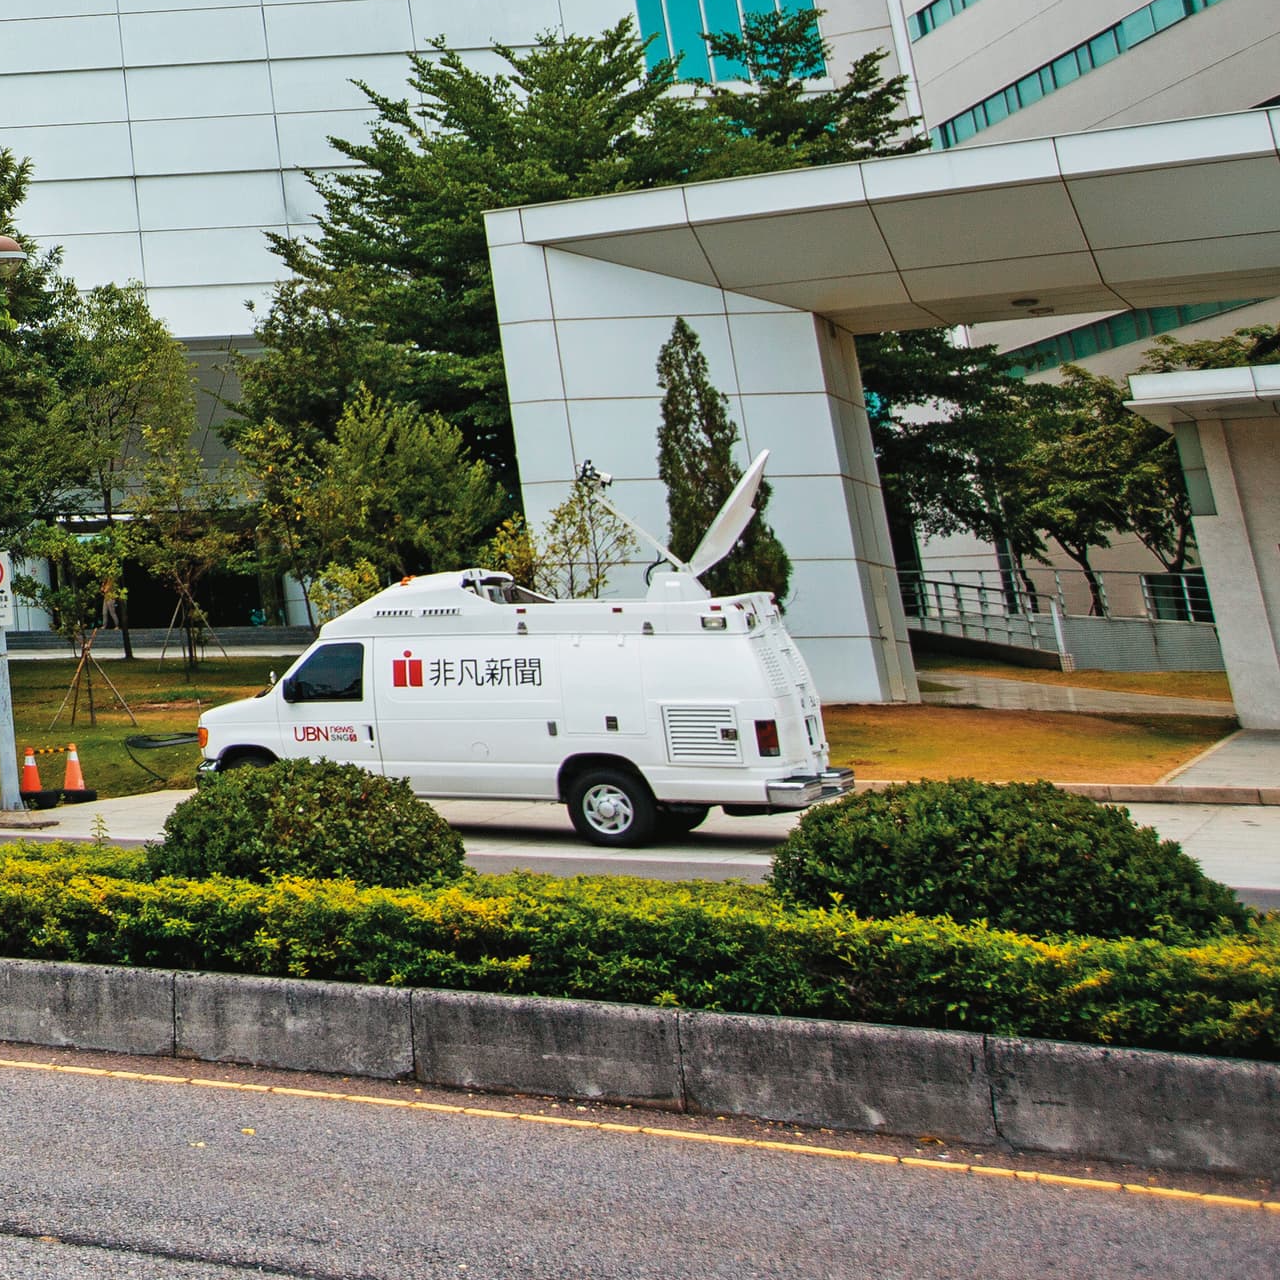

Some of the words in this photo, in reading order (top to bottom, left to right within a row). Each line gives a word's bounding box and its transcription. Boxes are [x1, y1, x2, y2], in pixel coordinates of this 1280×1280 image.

[429, 658, 542, 687] 非凡新聞
[294, 726, 329, 742] UBN
[330, 725, 354, 733] news
